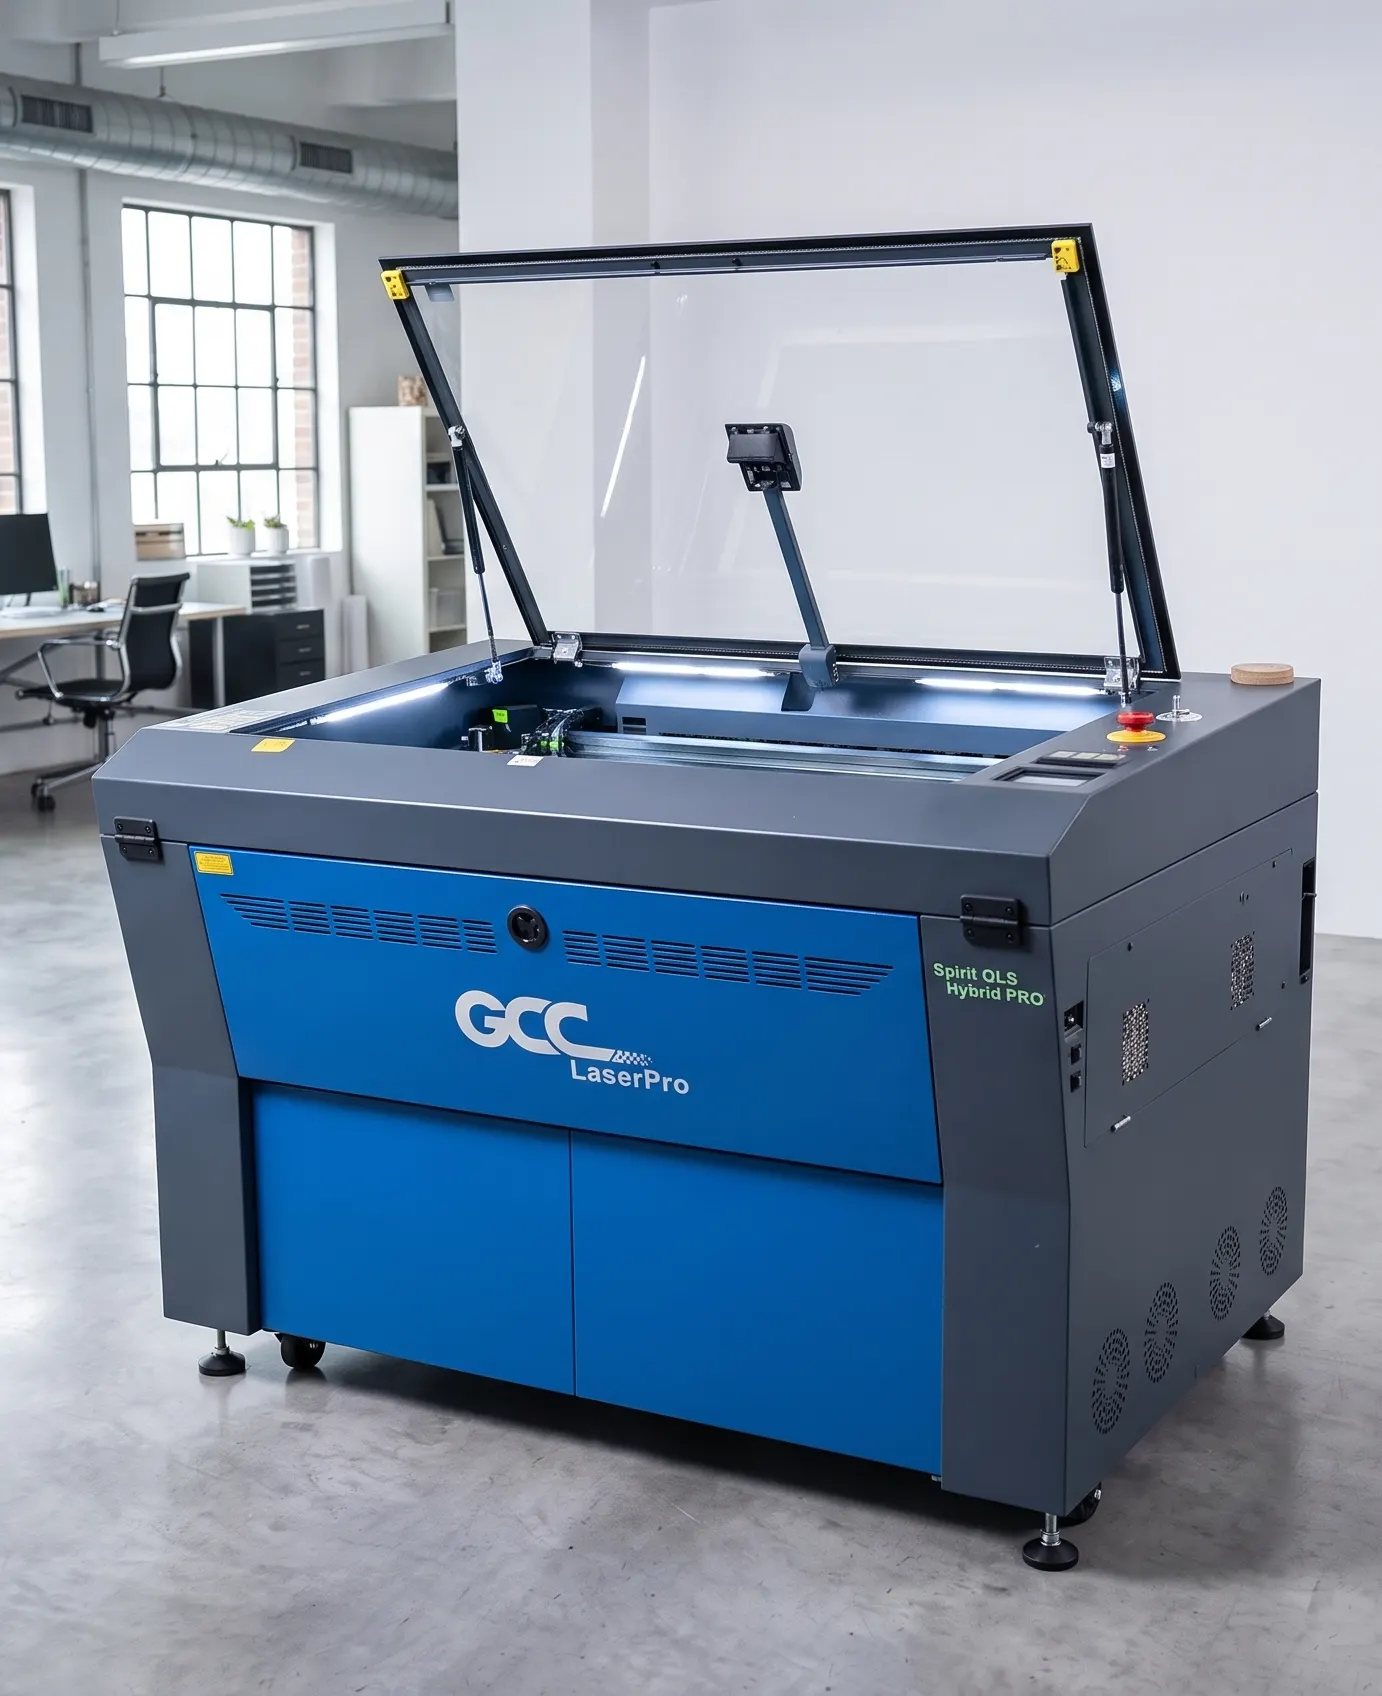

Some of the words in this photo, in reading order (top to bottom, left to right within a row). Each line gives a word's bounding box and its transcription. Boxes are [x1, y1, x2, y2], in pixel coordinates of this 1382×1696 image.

[933, 963, 978, 981] Spirit
[946, 981, 1001, 1000] Hybrid
[1006, 988, 1044, 1006] PRO
[455, 989, 616, 1062] GCC
[570, 1059, 690, 1095] LaserPro
